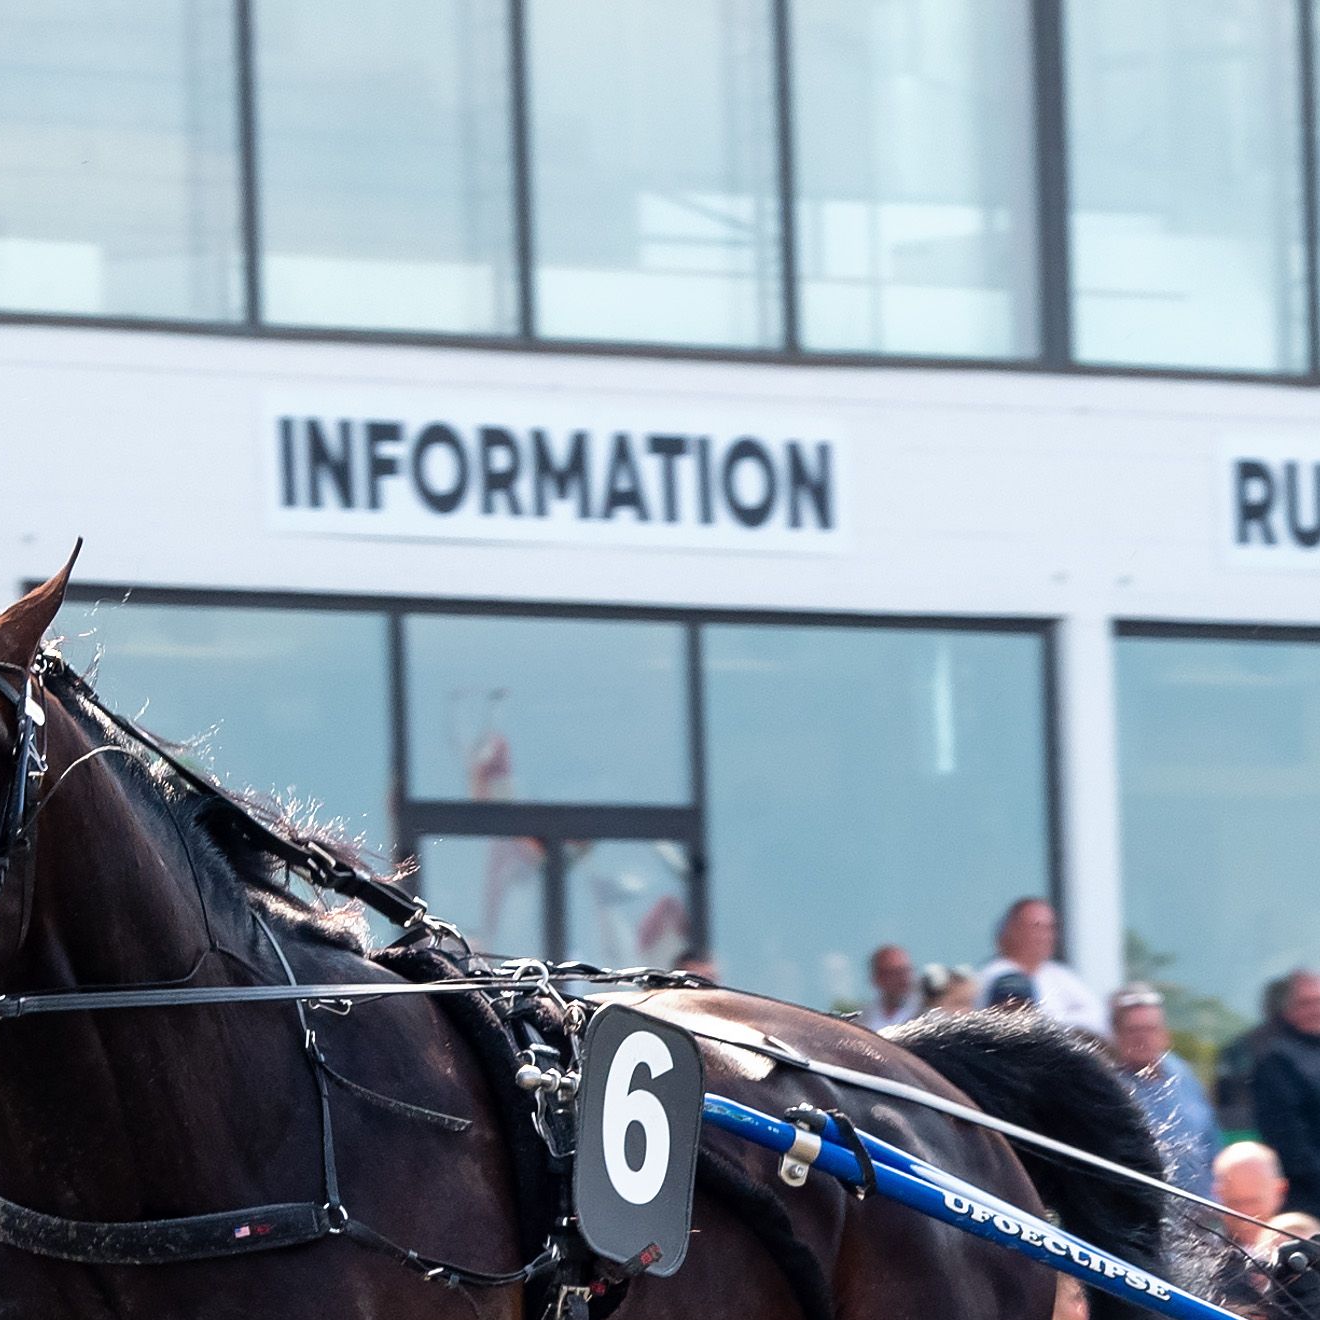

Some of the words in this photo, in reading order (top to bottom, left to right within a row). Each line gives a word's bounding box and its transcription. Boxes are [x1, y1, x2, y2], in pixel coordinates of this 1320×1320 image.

[280, 416, 834, 530] INFORMATION
[602, 1030, 674, 1205] 6
[942, 1190, 1171, 1302] UFOECLIPSE
